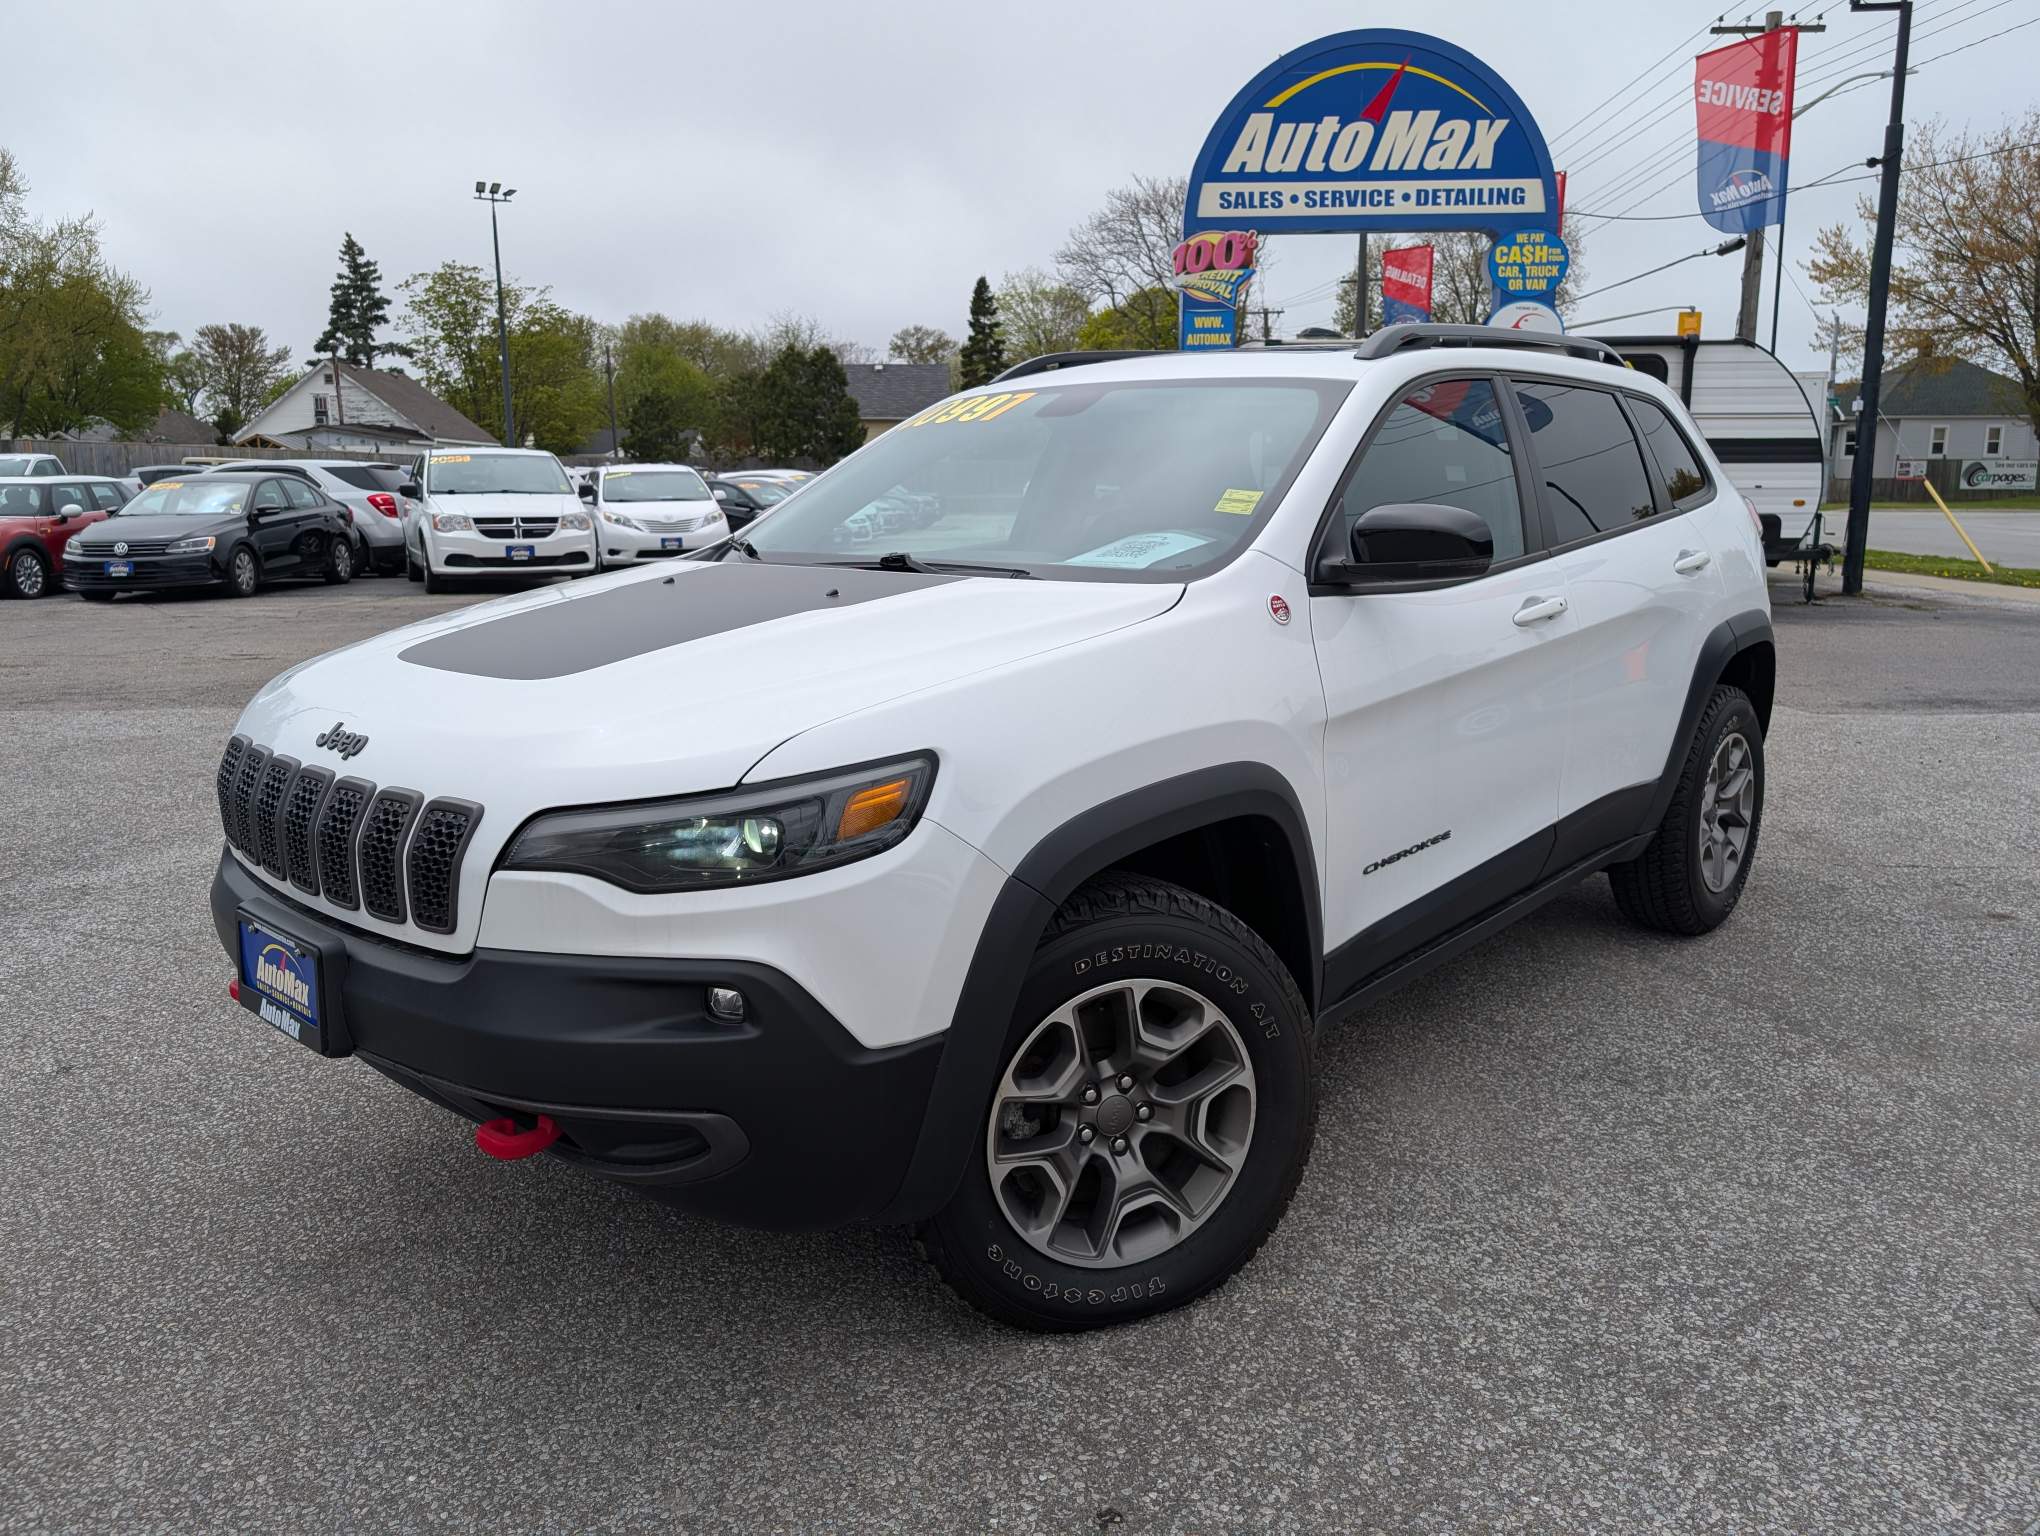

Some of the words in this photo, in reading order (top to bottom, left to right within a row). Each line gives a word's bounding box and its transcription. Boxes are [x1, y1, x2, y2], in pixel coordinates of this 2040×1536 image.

[1219, 190, 1284, 210] SALES
[1304, 188, 1395, 208] SERVICE
[1415, 186, 1525, 207] DETAILING
[1516, 233, 1529, 243] WE
[1530, 233, 1545, 243] PAY
[1172, 229, 1259, 276] 100%
[1196, 270, 1244, 283] REDIT
[1525, 265, 1559, 277] TRUCK
[1508, 278, 1522, 290] OR
[1526, 278, 1548, 290] VAN
[1186, 333, 1232, 346] AUTOMAX
[316, 721, 369, 761] Jeep
[1363, 829, 1452, 875] CHEROKEE
[1074, 944, 1249, 995] DESTINATION
[1250, 1001, 1281, 1040] A/T
[987, 1244, 1167, 1305] Firestone
